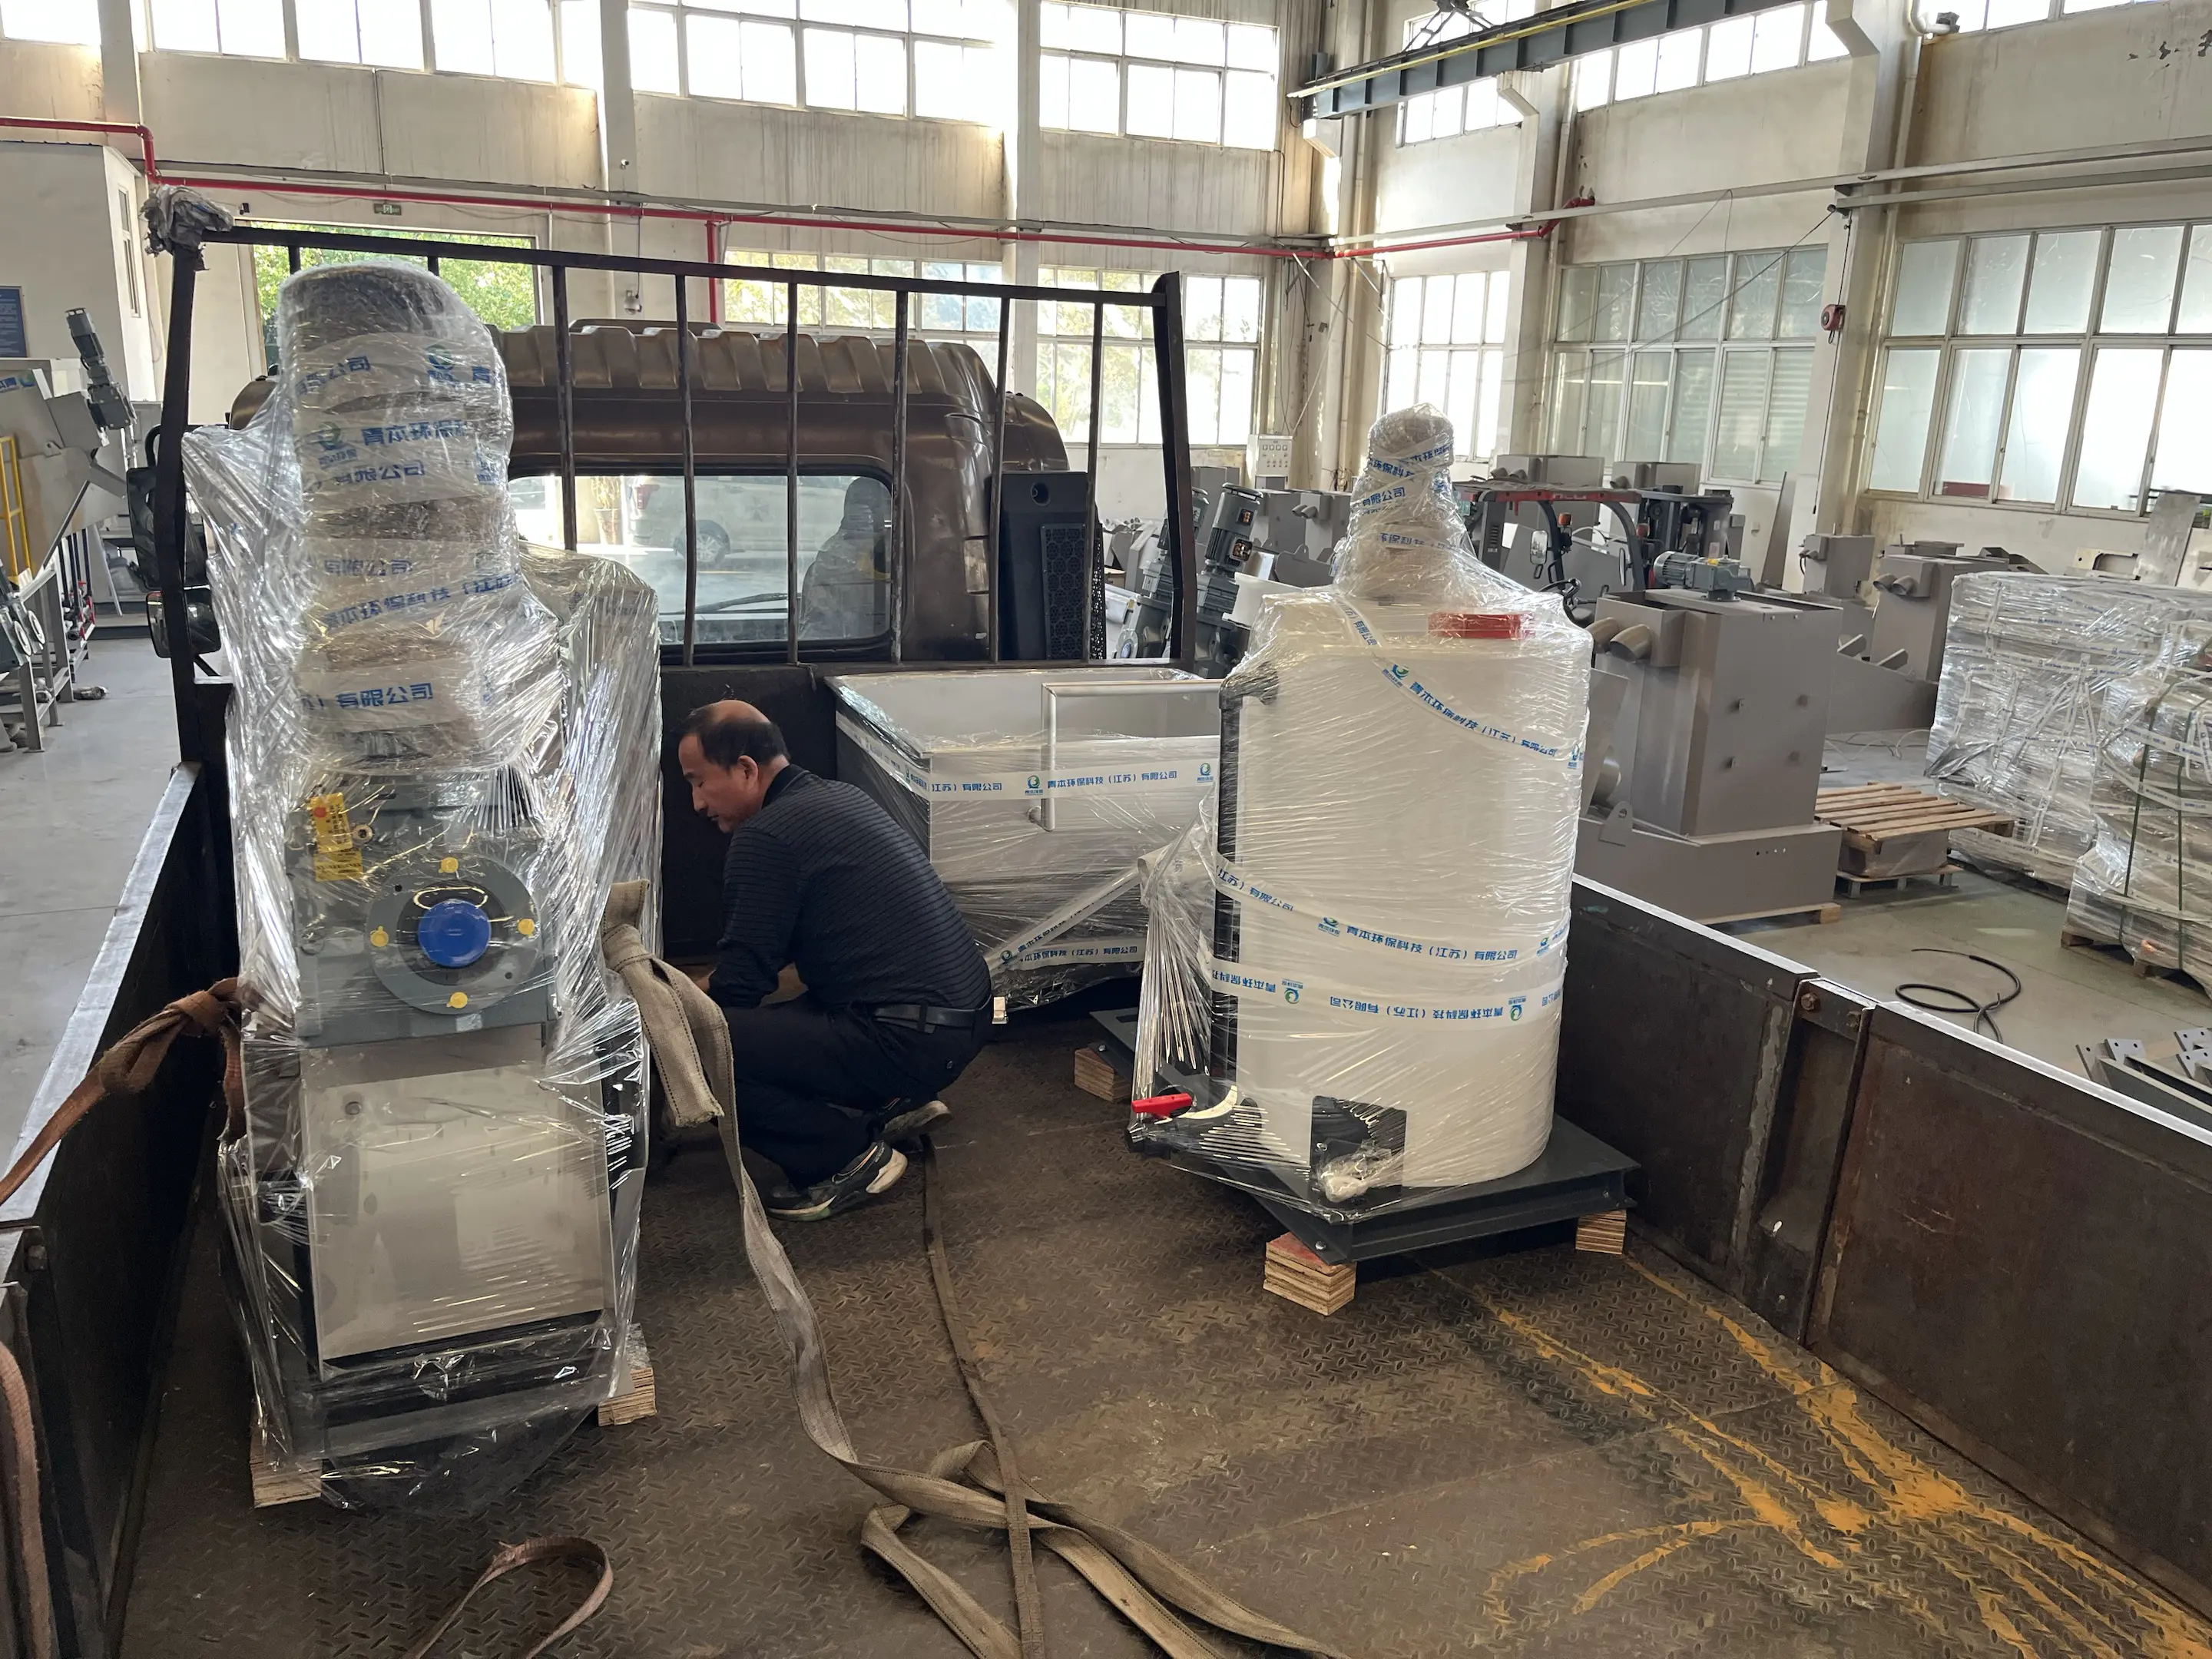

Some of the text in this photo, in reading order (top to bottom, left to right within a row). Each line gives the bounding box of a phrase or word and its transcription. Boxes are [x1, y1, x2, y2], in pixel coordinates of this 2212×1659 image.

[1020, 946, 1137, 962] 本环保科技（江苏）有限公司
[1346, 926, 1518, 961] 青本环保科技（江苏）有限公司
[1330, 996, 1503, 1019] 青本环保科技（江苏）有限公司
